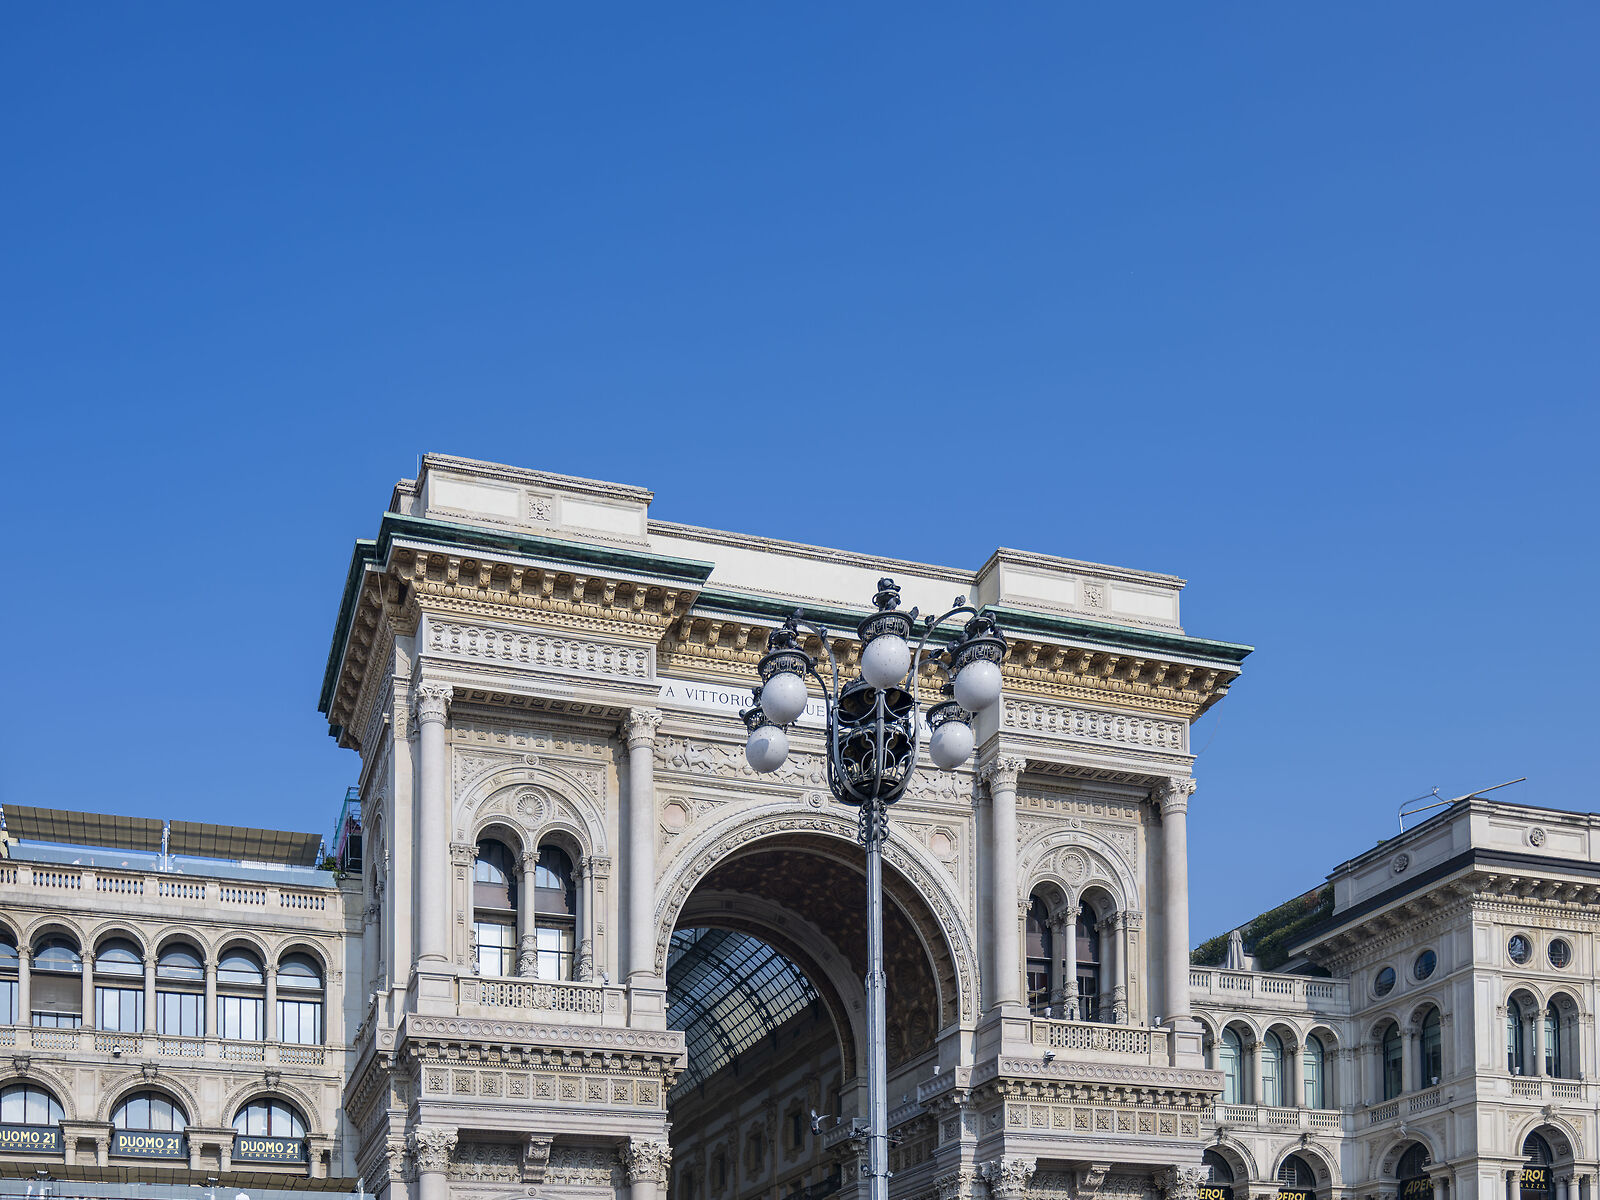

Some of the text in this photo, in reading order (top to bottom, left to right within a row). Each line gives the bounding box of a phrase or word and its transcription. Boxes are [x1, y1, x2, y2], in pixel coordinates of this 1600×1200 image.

[665, 686, 754, 708] A VITTORIO
[0, 1130, 56, 1144] UOMO 21
[119, 1135, 179, 1150] DUOMO 21
[119, 1147, 179, 1155] TERRAZZA
[240, 1140, 299, 1154] DUOMO 21
[1519, 1168, 1546, 1182] EROL
[1403, 1178, 1434, 1197] APER
